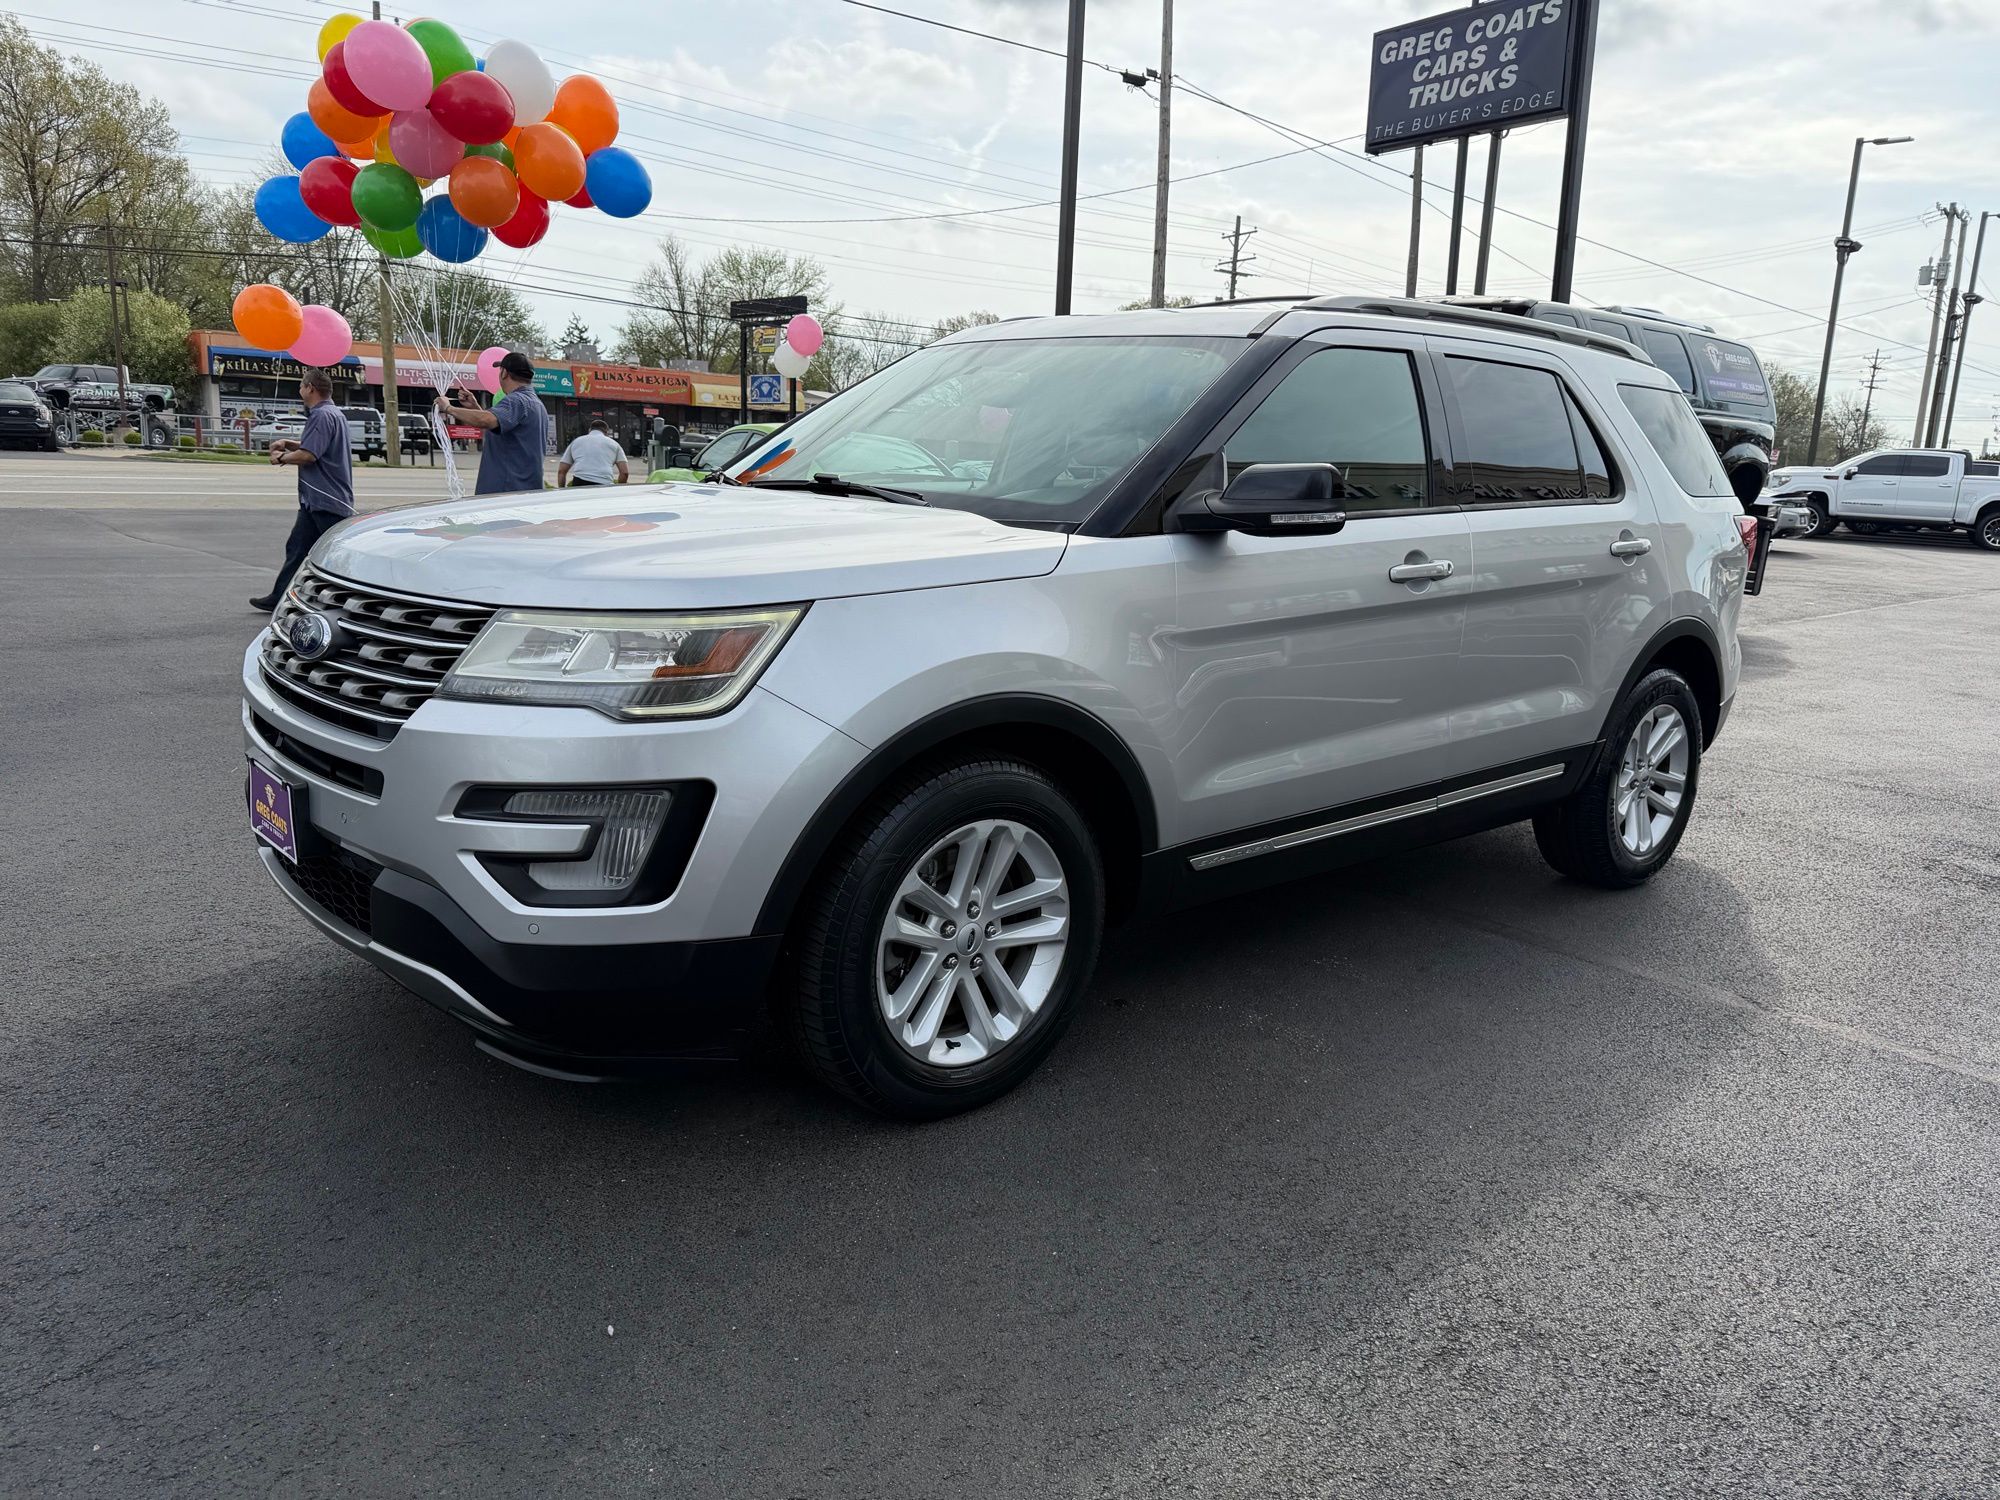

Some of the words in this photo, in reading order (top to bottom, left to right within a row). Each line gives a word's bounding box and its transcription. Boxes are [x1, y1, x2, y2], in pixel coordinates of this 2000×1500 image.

[1380, 26, 1453, 65] GREG
[1465, 0, 1562, 44] COATS
[1412, 44, 1488, 83] CARS
[1499, 37, 1518, 62] &
[1408, 64, 1519, 109] TRUCKS
[1374, 121, 1406, 139] THE
[1411, 103, 1492, 132] BUYER'S
[1500, 90, 1555, 114] EDGE
[226, 357, 269, 373] KEILA'S
[594, 371, 632, 383] LUNA'S
[635, 375, 688, 387] MEXICAN
[74, 388, 139, 398] TERMINAOR
[256, 799, 270, 820] GREG
[271, 811, 287, 834] COATS
